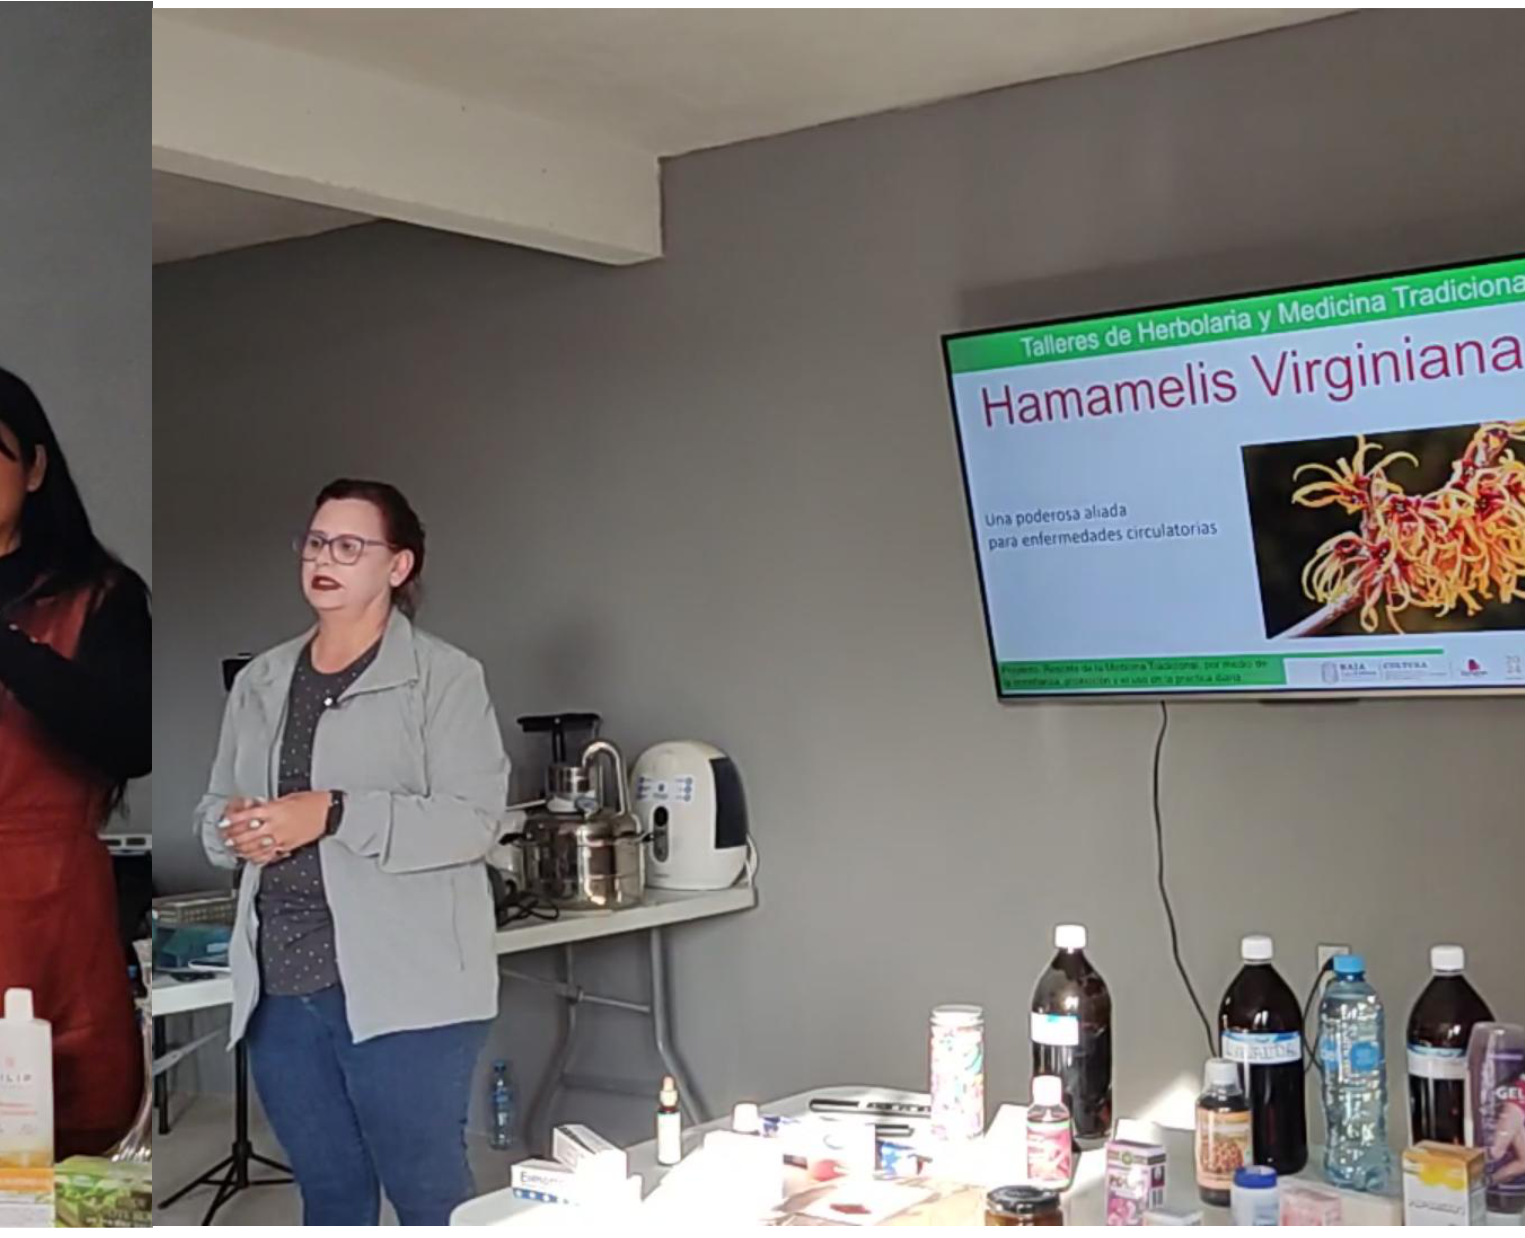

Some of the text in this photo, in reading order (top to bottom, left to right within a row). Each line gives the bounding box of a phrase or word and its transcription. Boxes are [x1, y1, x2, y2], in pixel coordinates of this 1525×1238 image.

[1020, 274, 1525, 358] Talleres de Herbolaria y Medicina Tradiciona
[981, 335, 1523, 427] Hamamelis Virginiana
[985, 502, 1127, 528] Una poderosa aliada
[988, 521, 1218, 551] para enfermedades circulatorias
